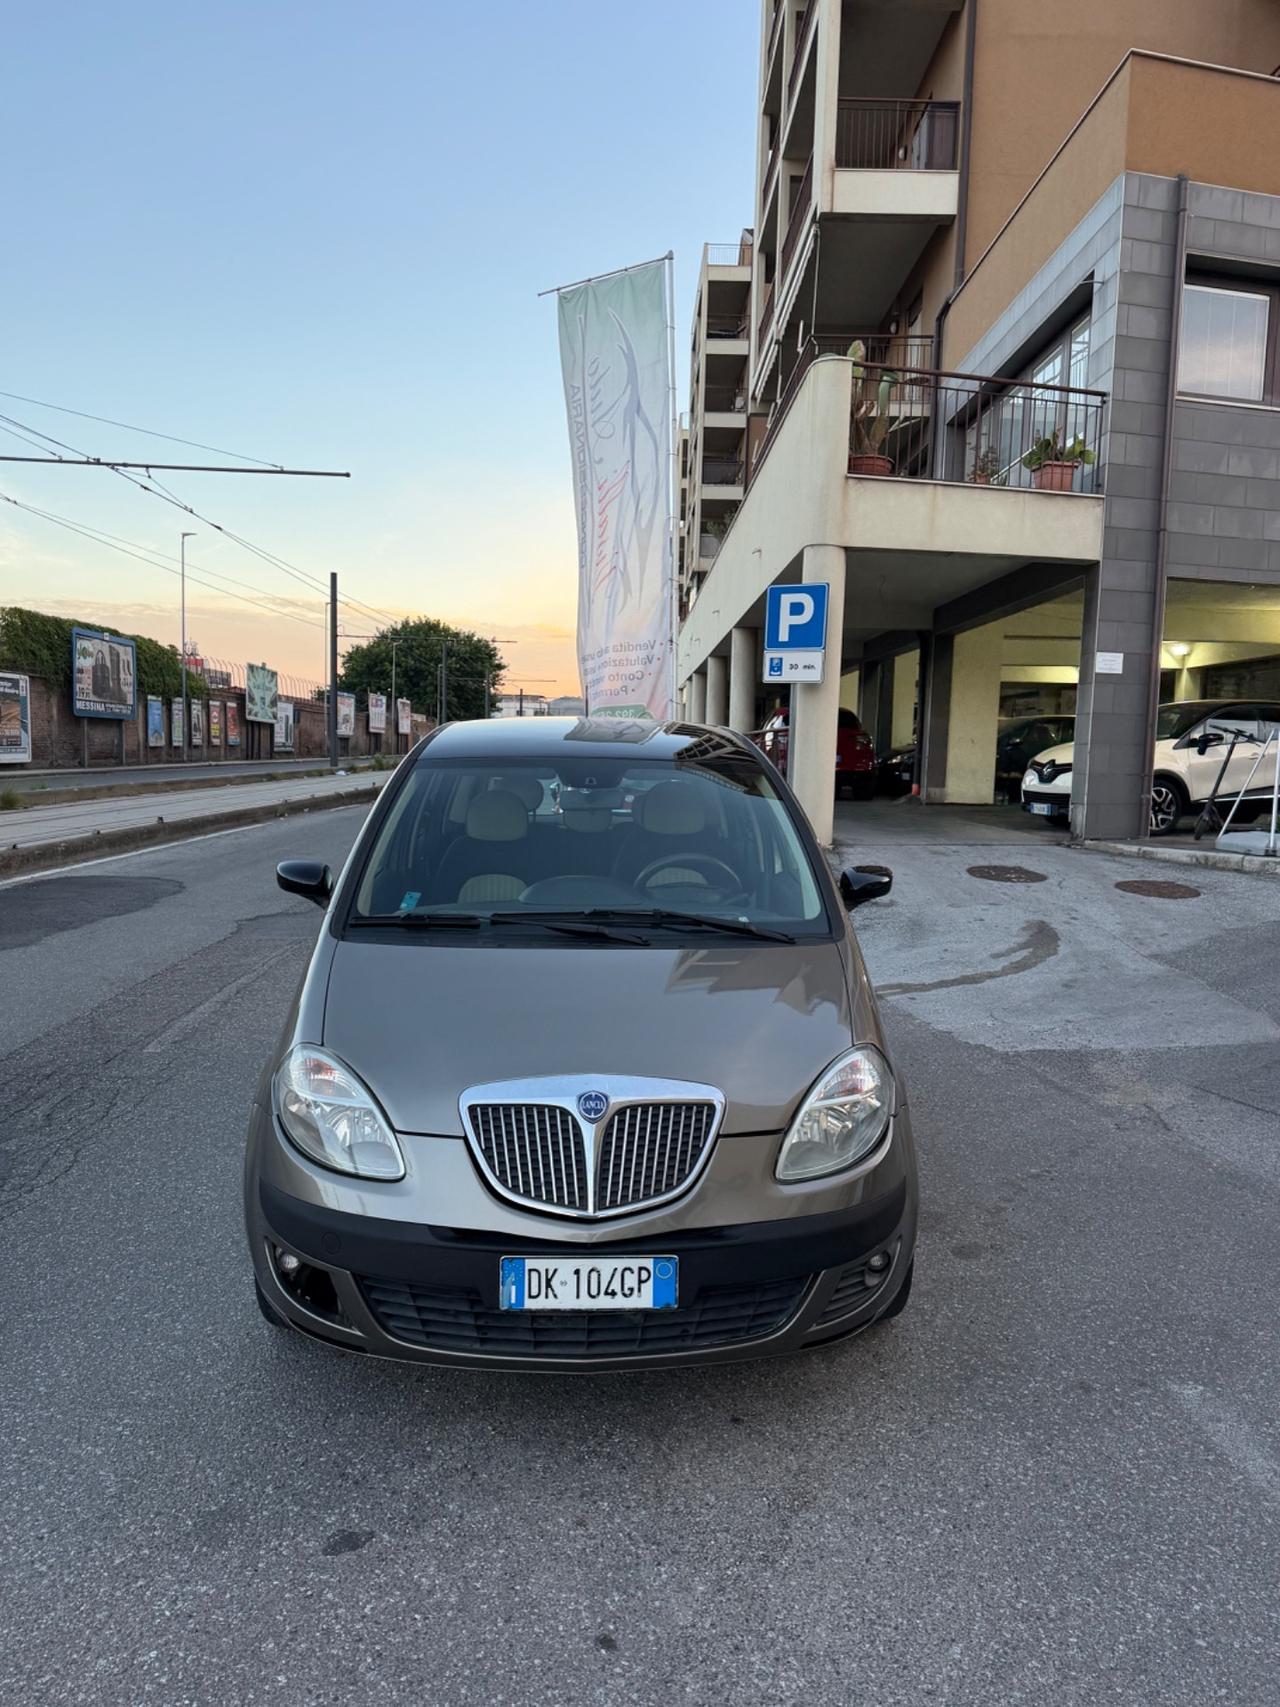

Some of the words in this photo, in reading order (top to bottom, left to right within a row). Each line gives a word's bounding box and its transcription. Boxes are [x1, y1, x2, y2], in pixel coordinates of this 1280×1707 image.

[778, 592, 815, 642] P
[527, 1268, 558, 1299] DK
[573, 1266, 651, 1299] 104GP
